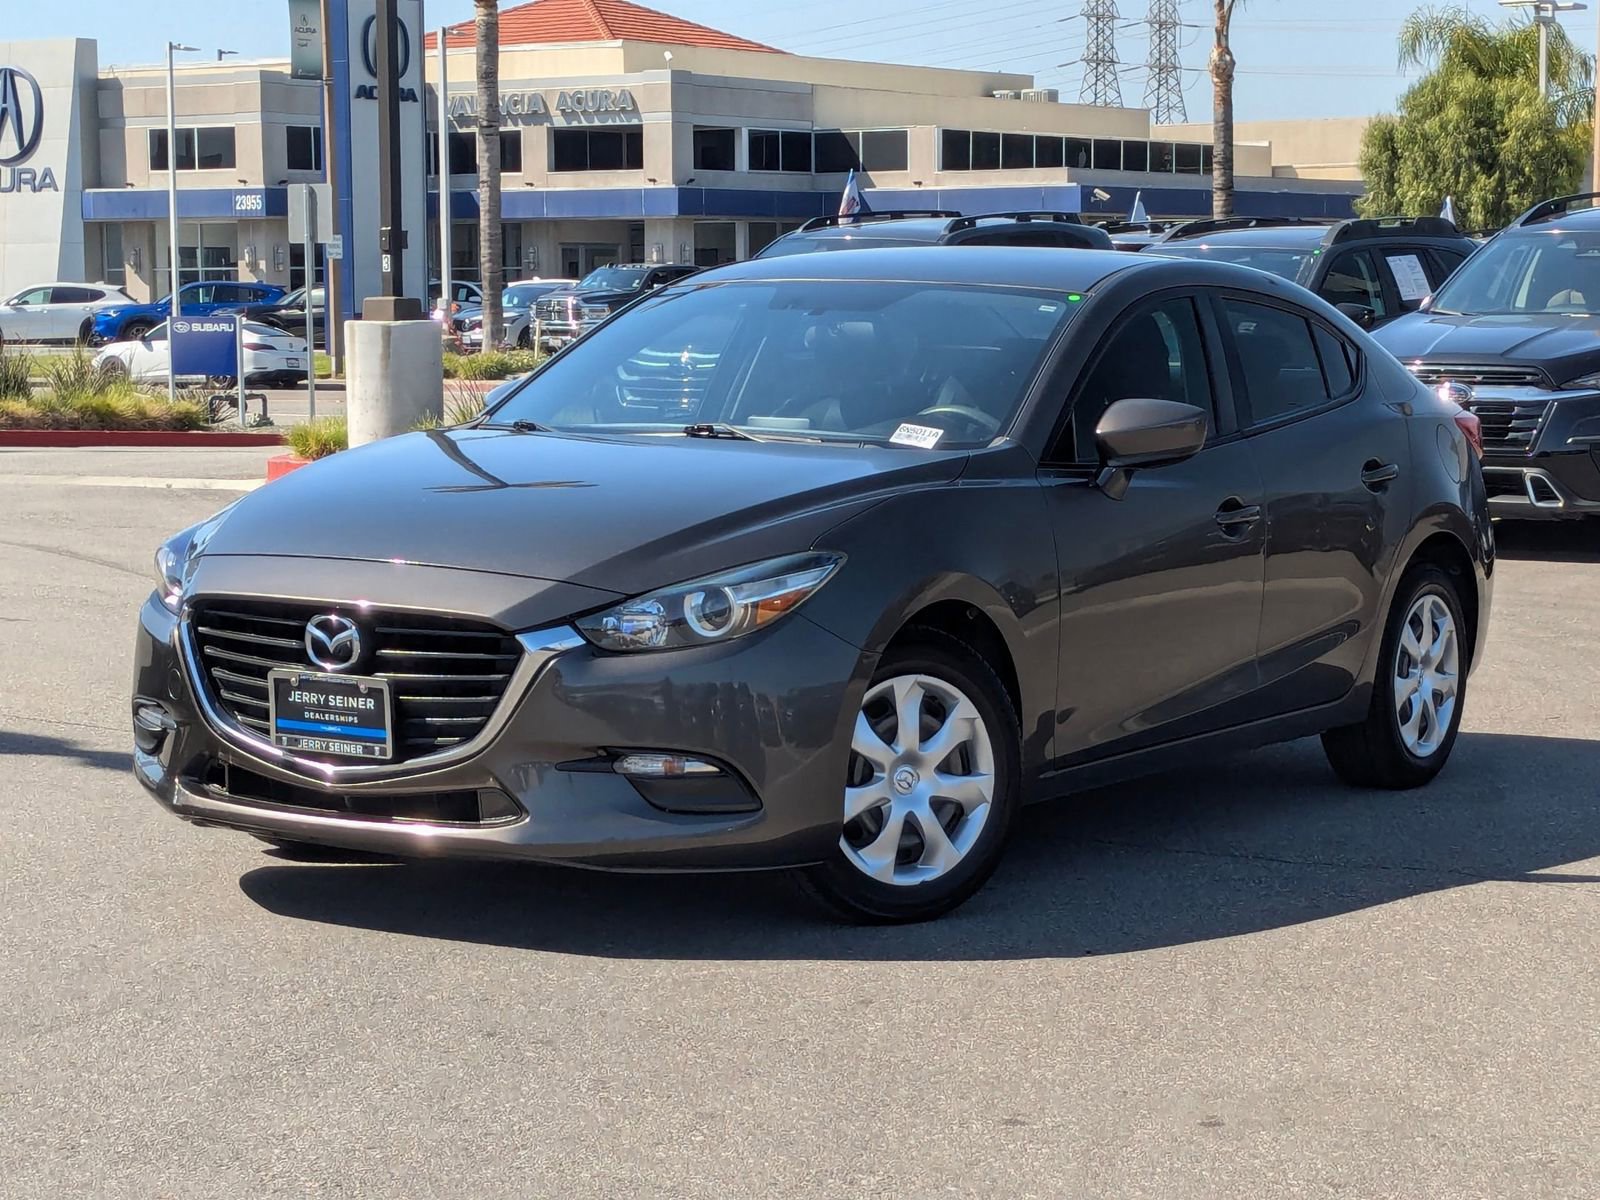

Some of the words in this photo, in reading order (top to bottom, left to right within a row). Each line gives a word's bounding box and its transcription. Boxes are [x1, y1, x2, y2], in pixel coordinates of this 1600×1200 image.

[354, 84, 419, 102] ACRA
[447, 92, 545, 116] VALNCIA
[556, 89, 632, 112] ACURA
[235, 194, 262, 210] 23955
[383, 255, 390, 271] 3
[191, 322, 234, 332] SUBARU
[288, 690, 326, 705] JERRY
[328, 695, 375, 710] SEINER
[304, 711, 358, 723] DEALERSHIPS
[298, 738, 327, 750] JERRY
[328, 742, 363, 754] SEINER
